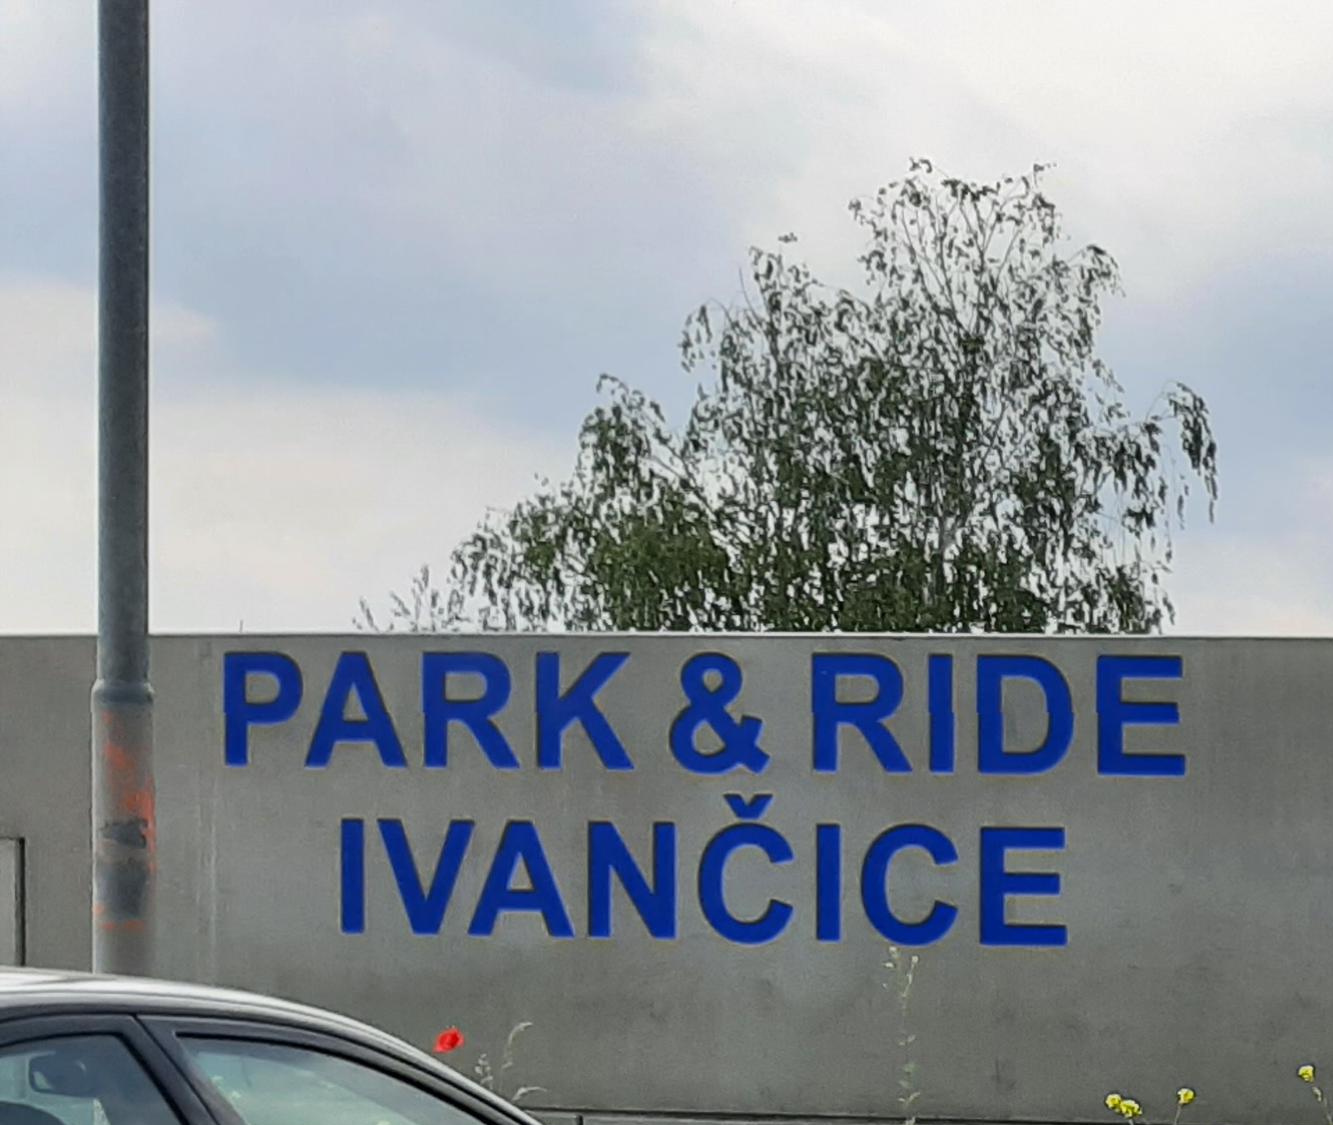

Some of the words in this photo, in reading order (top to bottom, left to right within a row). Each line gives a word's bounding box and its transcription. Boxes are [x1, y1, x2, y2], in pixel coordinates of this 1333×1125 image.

[223, 652, 634, 770] PARK
[669, 653, 770, 774] &
[811, 654, 1186, 776] RIDE
[340, 794, 1068, 946] IVANČICE
